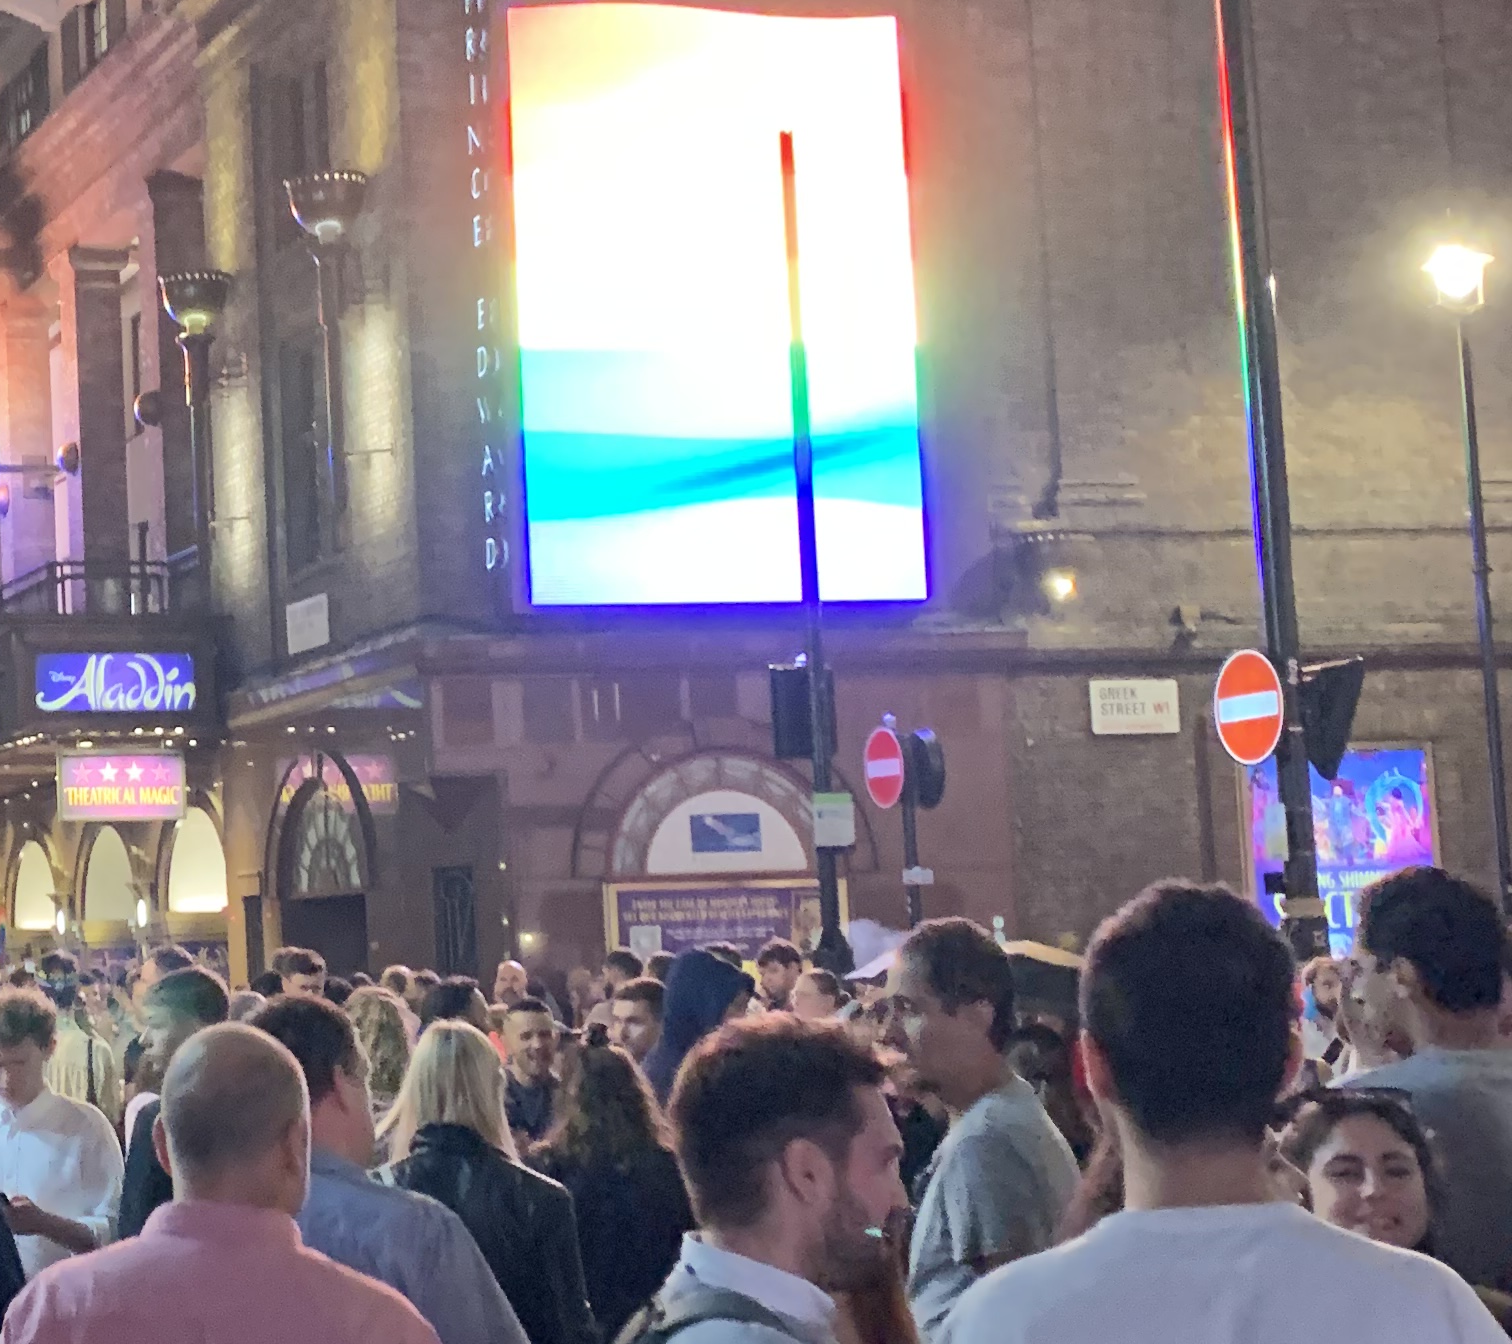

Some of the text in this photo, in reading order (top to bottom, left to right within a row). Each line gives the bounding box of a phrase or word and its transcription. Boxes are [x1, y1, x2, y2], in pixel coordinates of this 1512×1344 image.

[35, 652, 197, 711] Aladdin
[1099, 687, 1138, 701] GREEK
[1100, 701, 1170, 716] STREET W1
